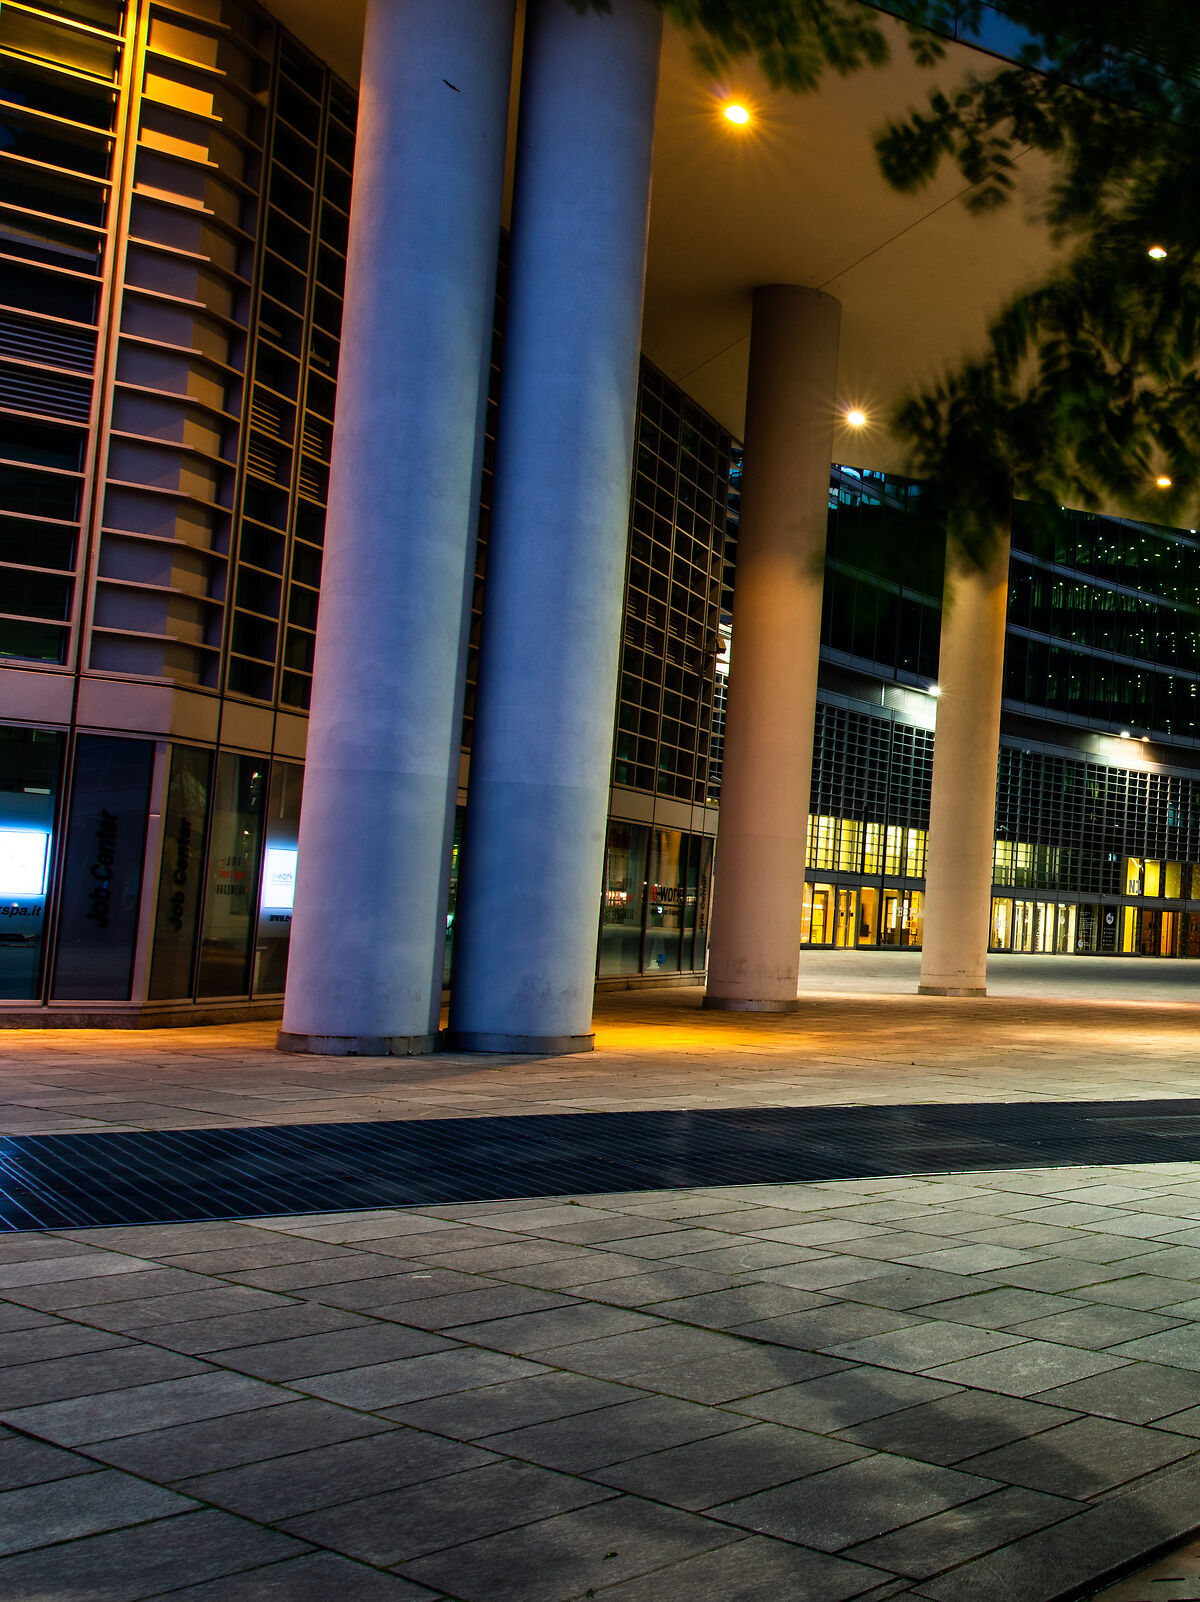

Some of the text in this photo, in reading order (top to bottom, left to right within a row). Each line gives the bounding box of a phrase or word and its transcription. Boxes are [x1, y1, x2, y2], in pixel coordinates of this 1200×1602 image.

[87, 809, 119, 929] Job Center
[169, 817, 193, 931] Job Center
[1128, 879, 1142, 895] N1
